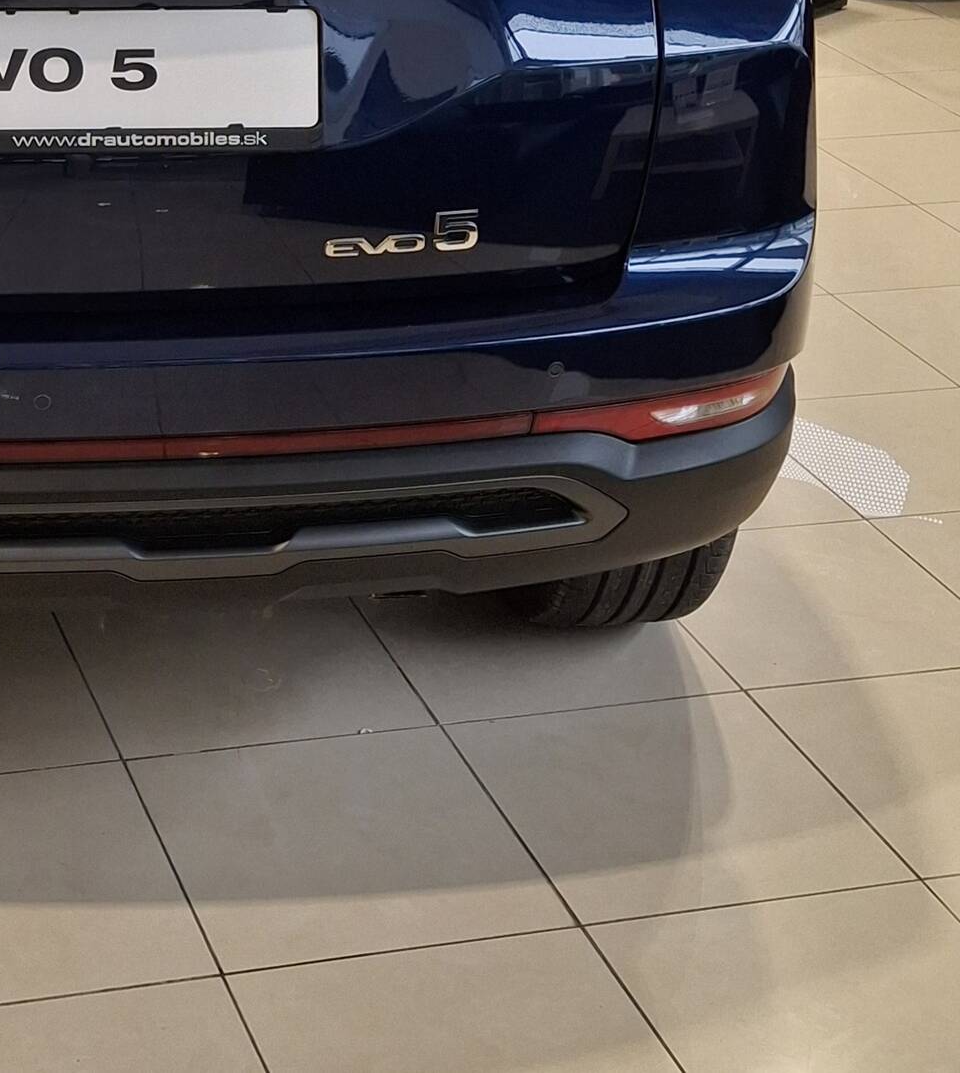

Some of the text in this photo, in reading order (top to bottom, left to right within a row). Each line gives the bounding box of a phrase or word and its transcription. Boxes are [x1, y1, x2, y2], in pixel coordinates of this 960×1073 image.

[110, 48, 158, 92] 5
[11, 130, 269, 148] www.drautomobiles.sk
[432, 208, 479, 252] 5
